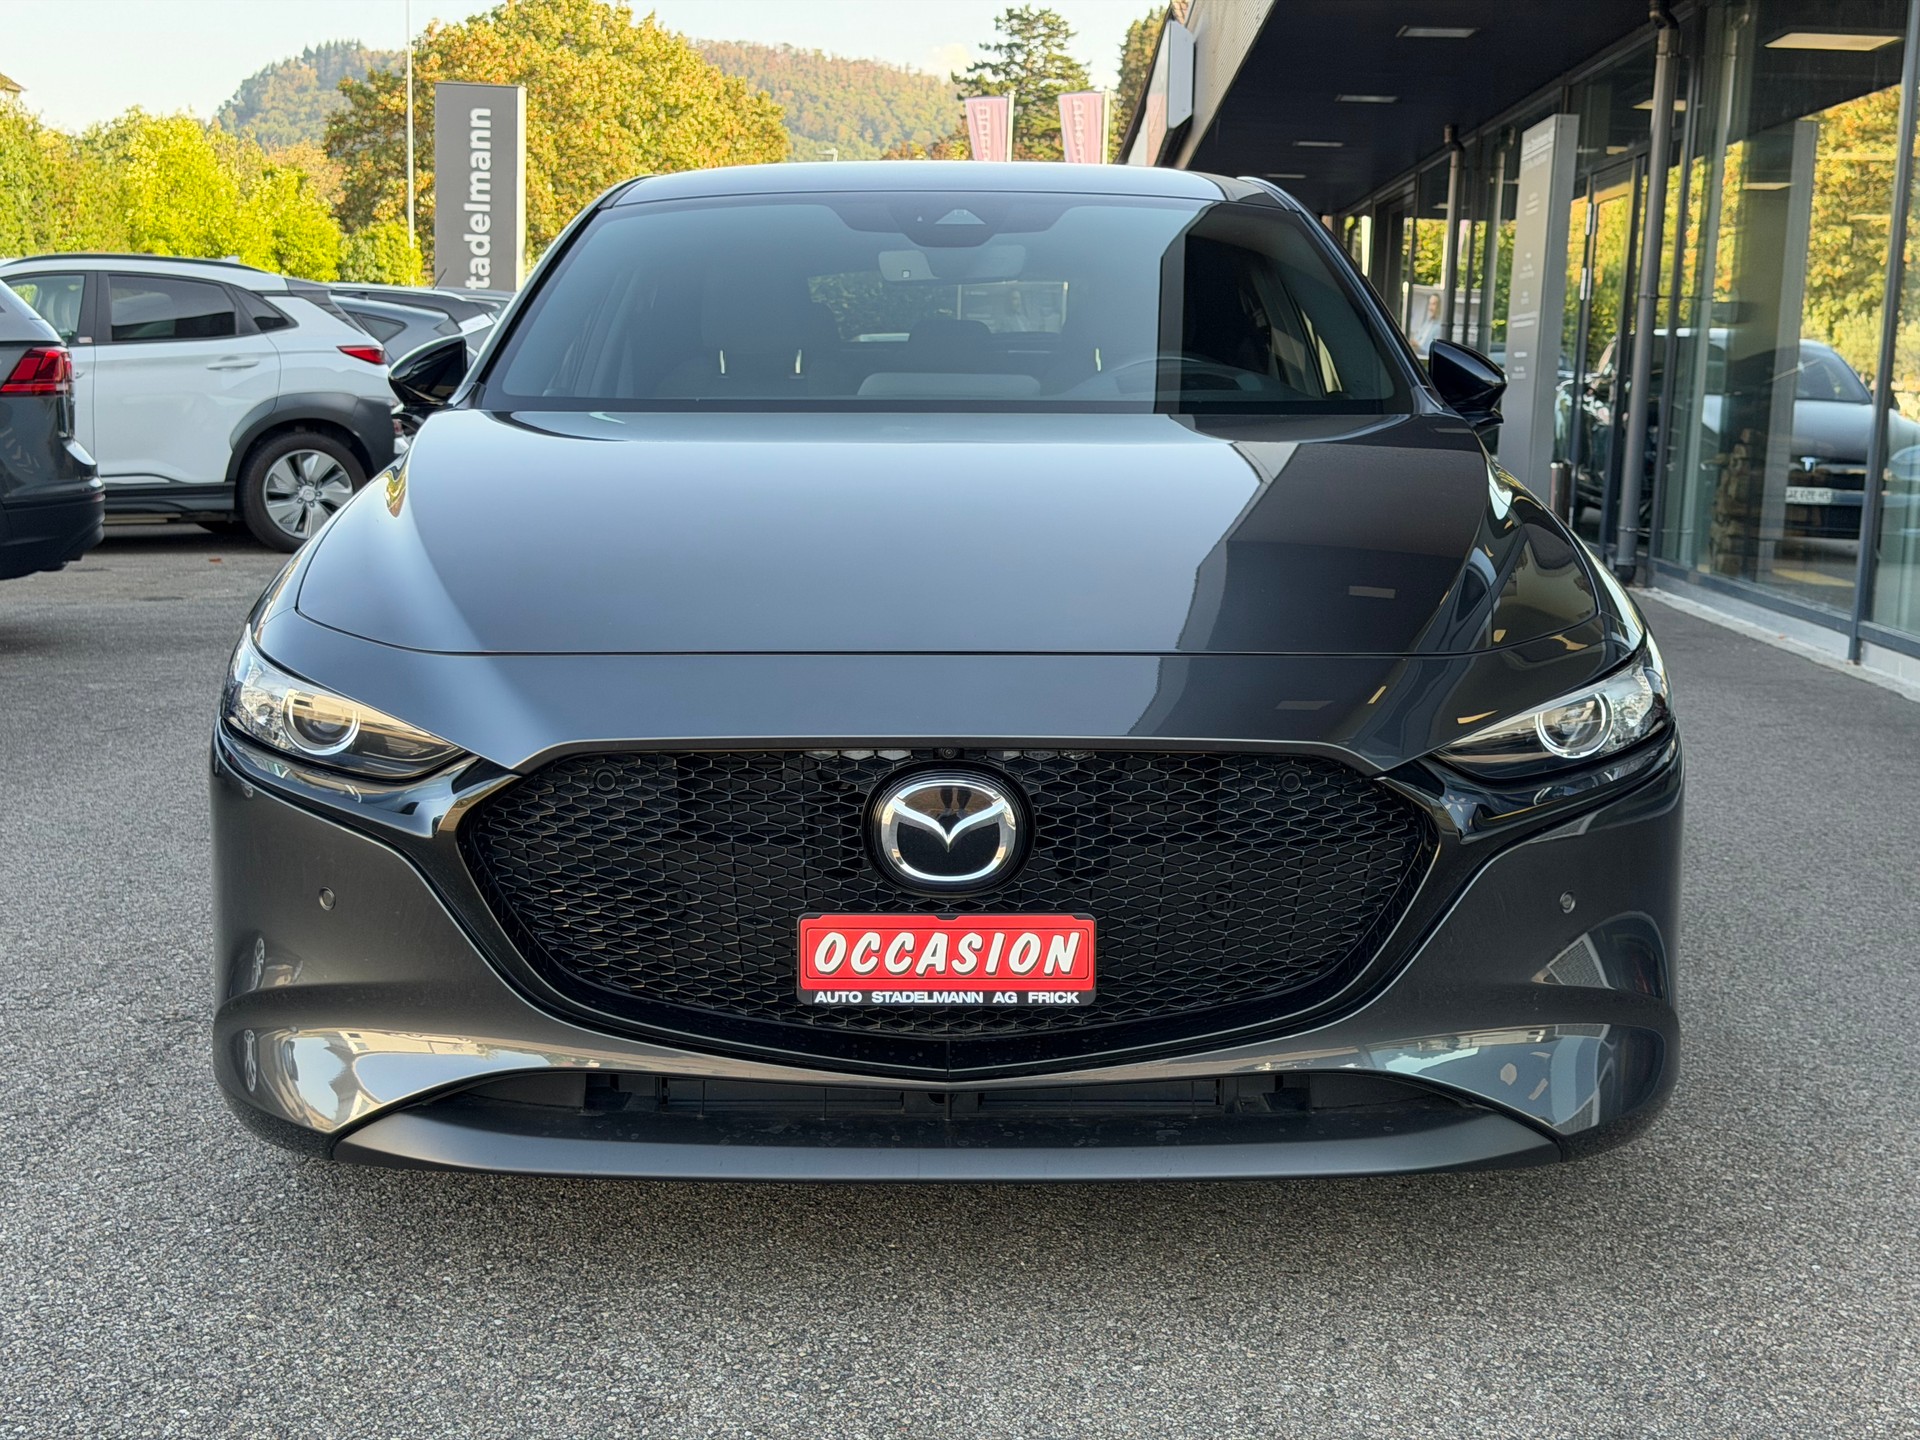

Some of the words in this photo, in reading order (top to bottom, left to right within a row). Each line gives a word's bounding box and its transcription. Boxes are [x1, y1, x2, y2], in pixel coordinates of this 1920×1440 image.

[814, 931, 1081, 976] OCCASION
[814, 991, 863, 1004] AUTO
[871, 991, 984, 1004] STADELMANN
[992, 991, 1018, 1004] AG
[1027, 991, 1080, 1004] FRICK
